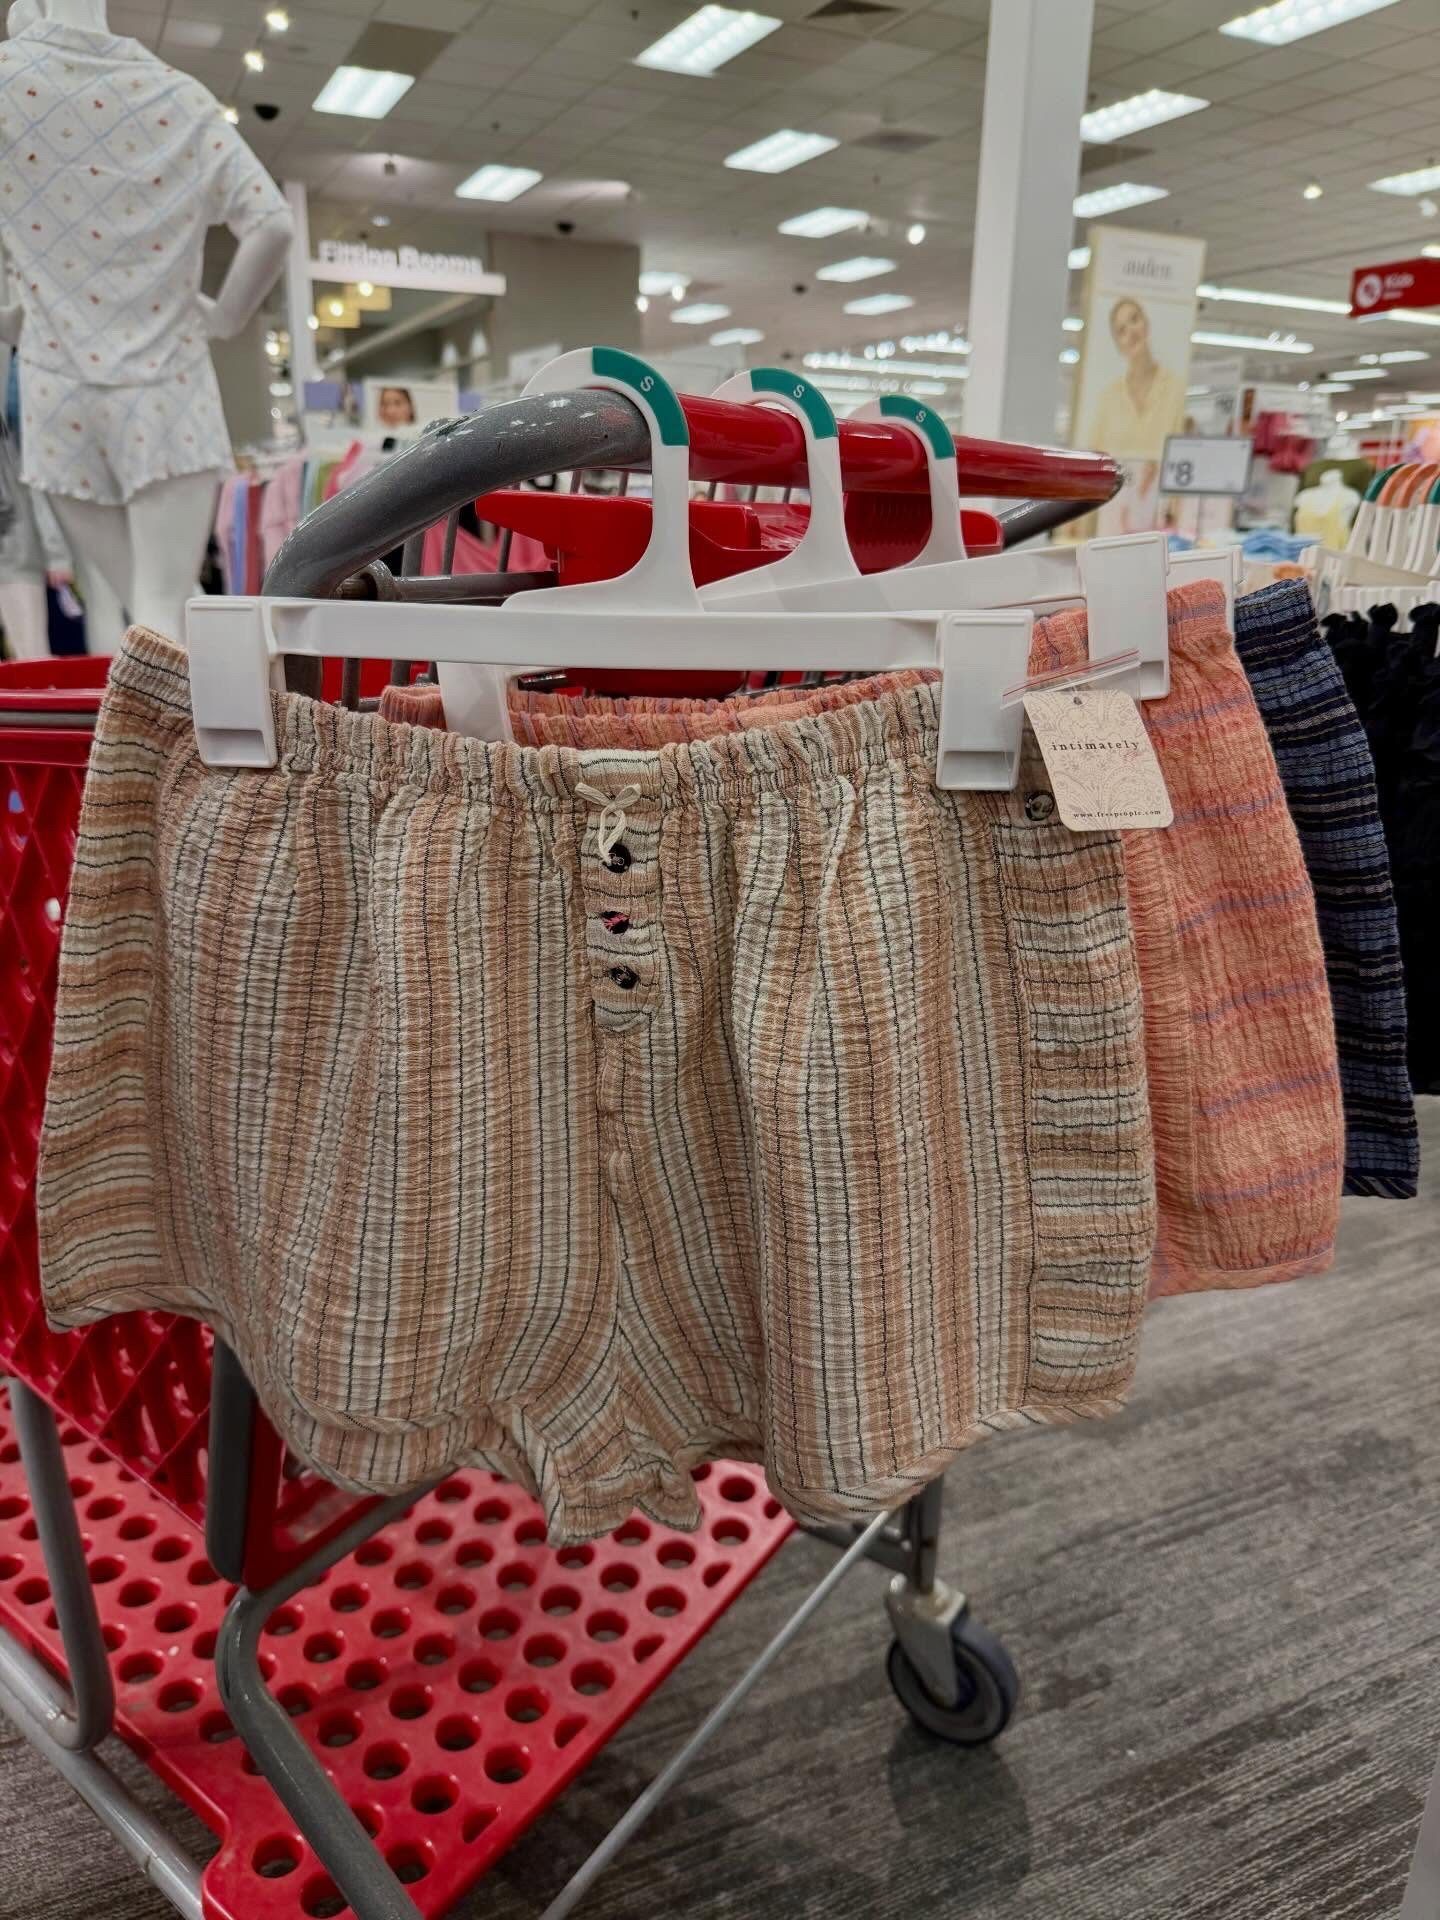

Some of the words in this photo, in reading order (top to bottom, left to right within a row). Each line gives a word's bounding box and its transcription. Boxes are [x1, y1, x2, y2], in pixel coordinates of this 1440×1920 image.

[399, 246, 483, 274] Rooms
[640, 375, 654, 392] S
[793, 384, 805, 398] S
[915, 410, 927, 423] S
[1052, 740, 1139, 751] intimately
[1073, 810, 1161, 819] www.freepeople.com
